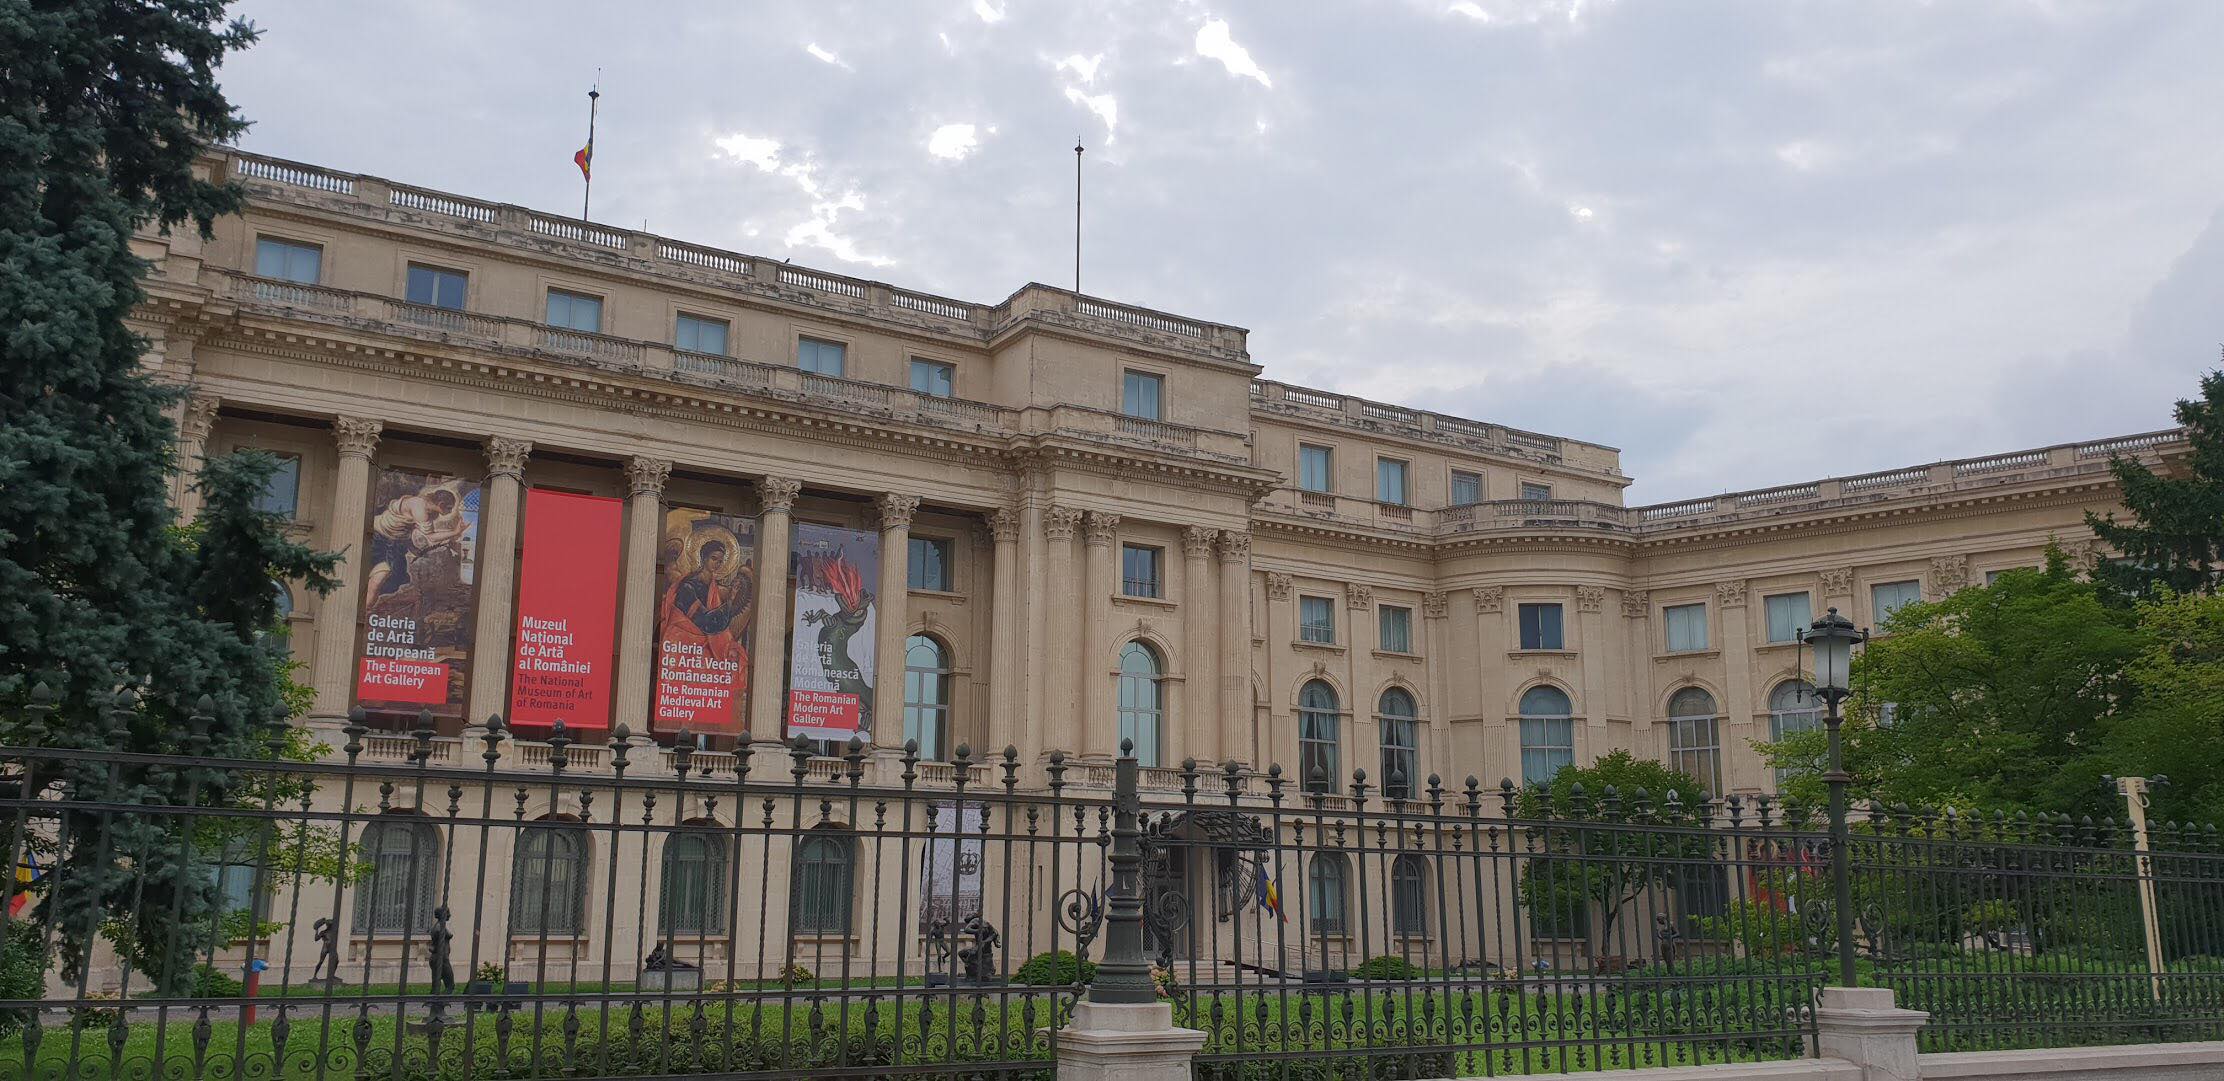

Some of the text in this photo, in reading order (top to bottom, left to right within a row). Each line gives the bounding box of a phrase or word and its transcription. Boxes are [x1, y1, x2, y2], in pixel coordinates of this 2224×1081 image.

[369, 614, 416, 630] Galeria
[522, 616, 566, 631] Muzeul
[368, 629, 414, 644] de Artă
[522, 630, 573, 645] Național
[367, 643, 435, 660] Europeană
[520, 644, 564, 658] de Artă
[663, 641, 703, 655] Galeria
[796, 639, 833, 652] Galeria
[519, 658, 591, 674] al României
[662, 655, 738, 671] de Artă Veche
[810, 653, 832, 665] Artă
[366, 660, 440, 676] The European
[364, 673, 424, 689] Art Gallery
[519, 674, 583, 687] The National
[661, 668, 732, 684] Românească
[661, 683, 729, 697] The Romanian
[794, 677, 840, 691] Modernă
[518, 686, 592, 699] Museum of Art
[794, 691, 856, 704] The Romanian
[516, 699, 575, 710] of Romania
[661, 695, 722, 709] Medieval Art
[793, 703, 843, 715] Modern Art
[660, 707, 695, 720] Gallery
[793, 714, 825, 726] Gallery
